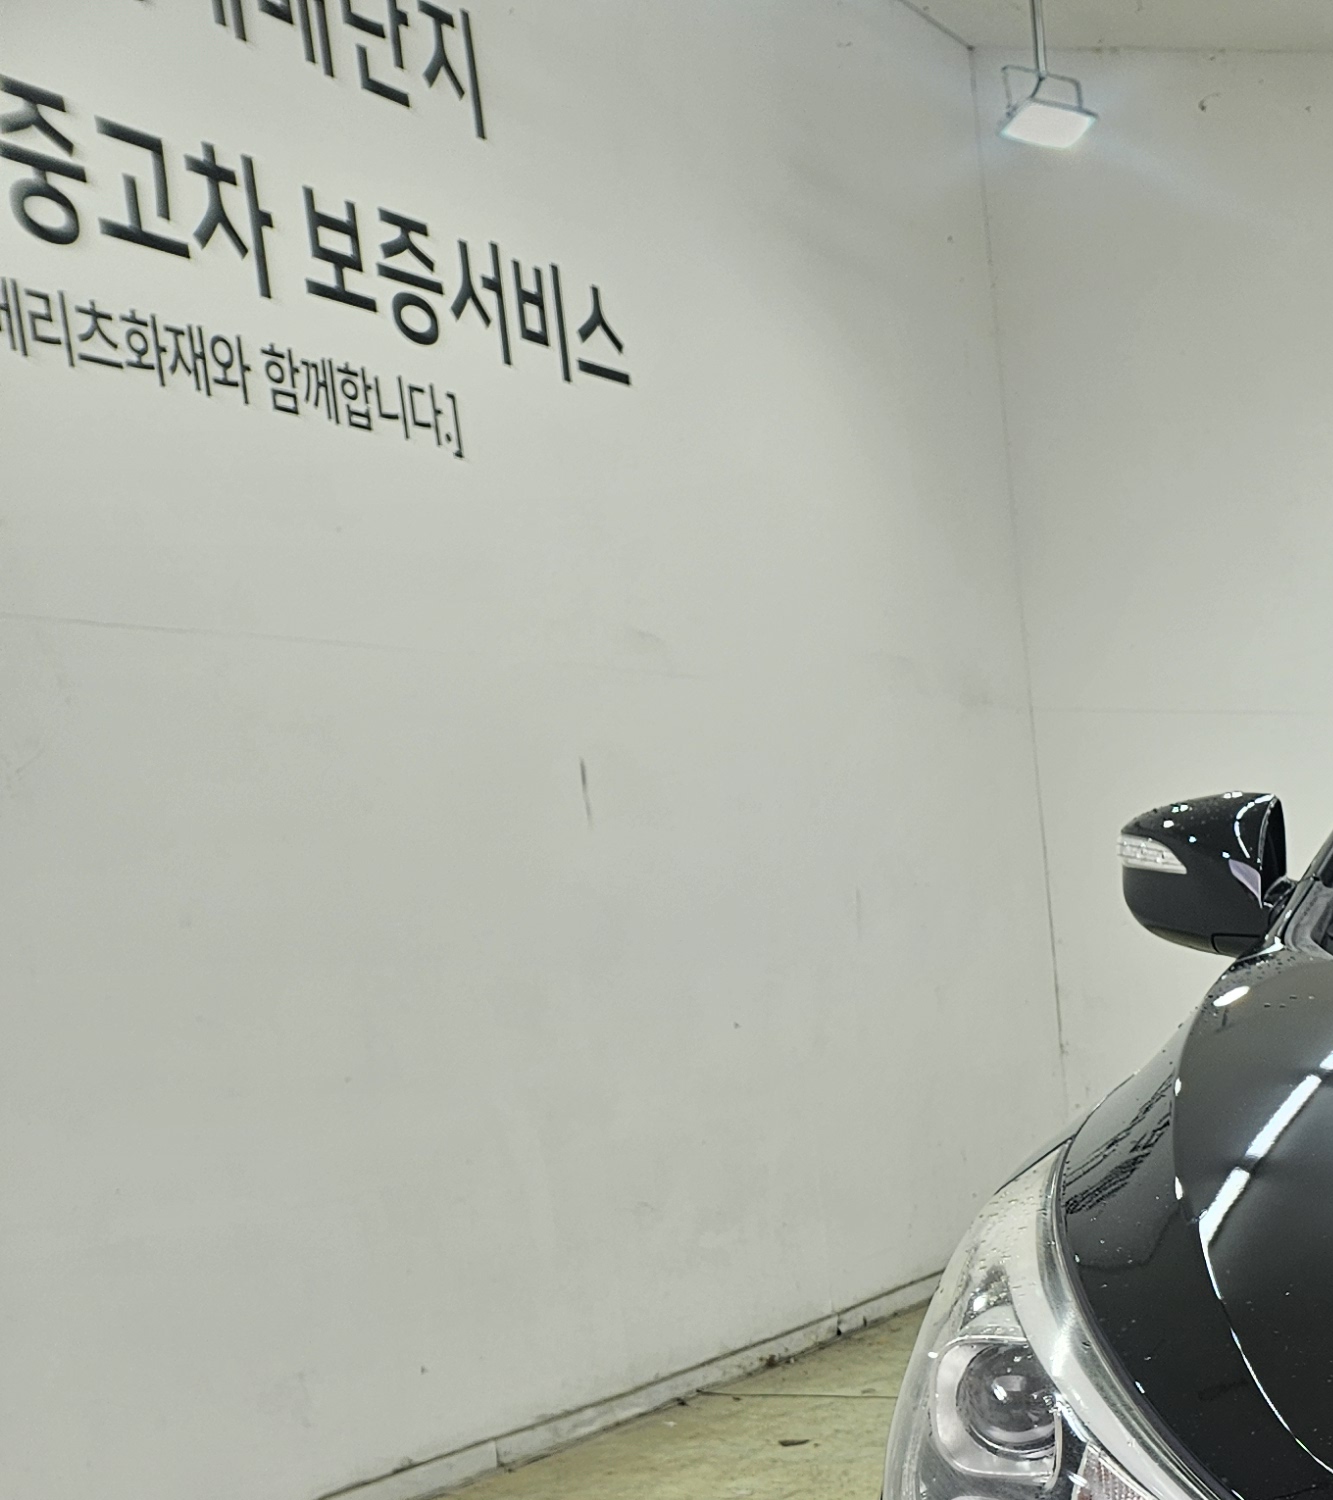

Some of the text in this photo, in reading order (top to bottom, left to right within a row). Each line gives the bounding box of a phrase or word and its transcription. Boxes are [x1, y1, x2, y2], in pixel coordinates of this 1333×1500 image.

[0, 74, 633, 387] 중고차 보증서비스
[262, 342, 466, 461] 함께합니다.]
